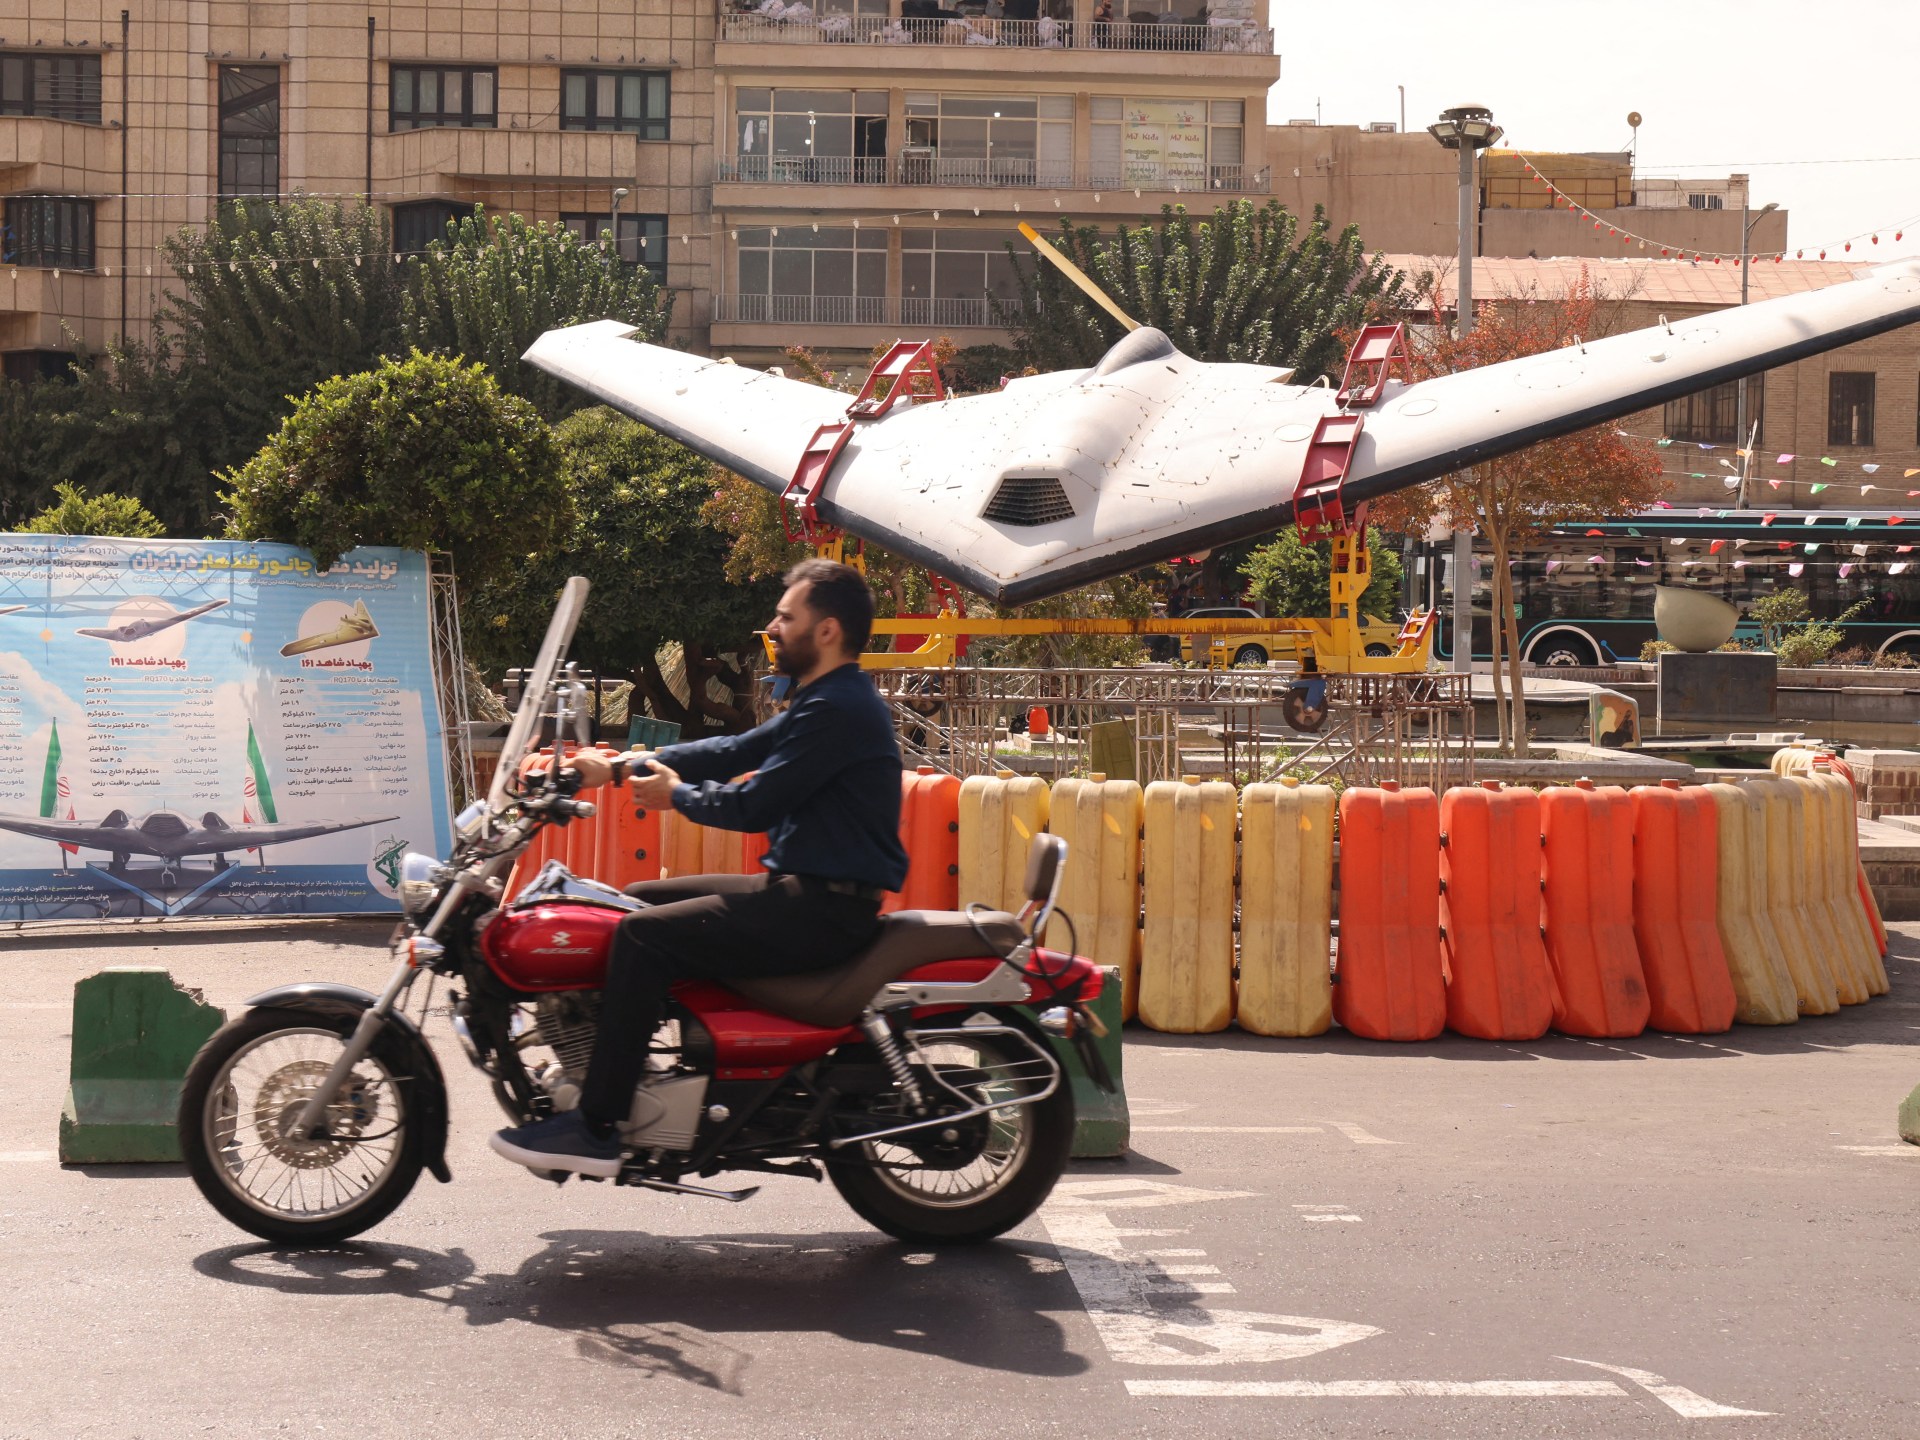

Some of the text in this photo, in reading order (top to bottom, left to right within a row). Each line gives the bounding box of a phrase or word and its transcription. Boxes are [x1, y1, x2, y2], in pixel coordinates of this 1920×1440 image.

[1126, 132, 1159, 141] MJ Kids
[1170, 133, 1200, 142] MJ Kids
[89, 547, 118, 556] RQ170
[15, 557, 34, 566] ارتش
[36, 558, 51, 566] های
[93, 560, 119, 568] محرمانه
[132, 552, 176, 572] ایران
[177, 555, 197, 573] در
[198, 553, 260, 574] قندهار
[260, 557, 312, 575] جانور
[352, 559, 398, 580] تولید
[111, 656, 186, 670] پهپاد شاهد ۱۹۱
[301, 658, 372, 671] پهپاد شاهد ۱۶۱
[191, 676, 213, 684] مقایسه
[87, 710, 110, 718] کیلوگرم
[282, 710, 304, 718] کیلوگرم
[306, 721, 328, 729] کیلومتر
[319, 766, 342, 774] کیلوگرم
[209, 791, 221, 799] نوع
[288, 790, 316, 798] میکروجت
[398, 788, 409, 796] نوع
